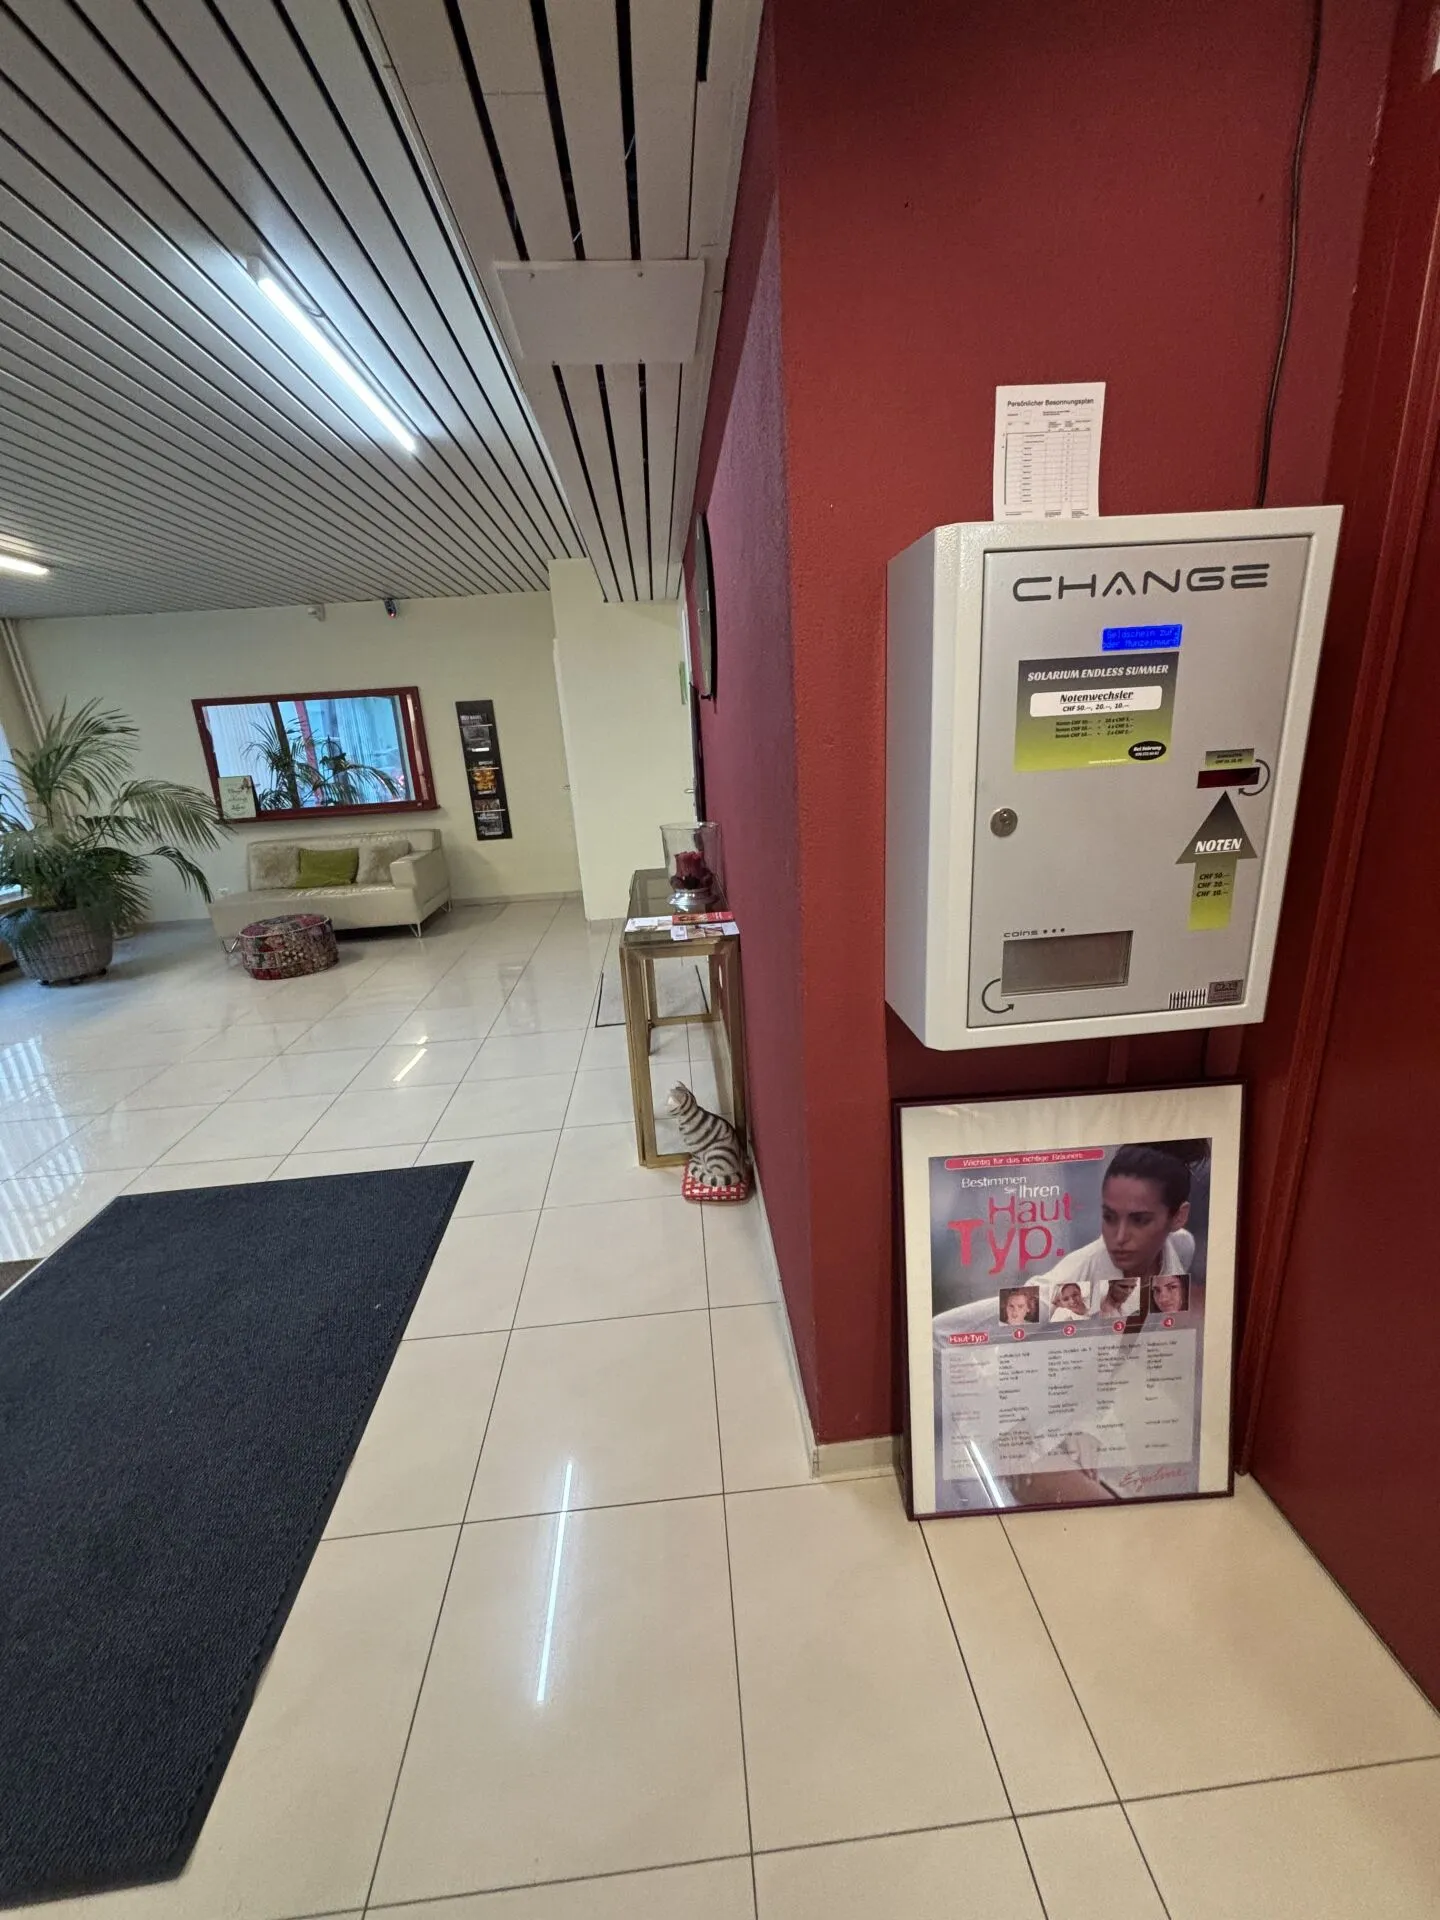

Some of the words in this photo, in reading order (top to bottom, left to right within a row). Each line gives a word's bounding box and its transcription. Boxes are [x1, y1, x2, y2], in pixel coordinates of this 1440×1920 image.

[1045, 398, 1094, 406] Besonnungsplan
[1013, 563, 1270, 602] CHANGE
[1027, 669, 1080, 682] SOLARIUM
[1080, 667, 1124, 678] ENDLESS
[1125, 665, 1169, 676] SUMMER
[1060, 690, 1134, 703] Notenwechsler
[1195, 838, 1242, 853] NOTEN
[1004, 929, 1038, 938] coins
[963, 1158, 990, 1167] Wichtig
[1006, 1156, 1020, 1164] das
[1022, 1155, 1049, 1164] richtige
[961, 1176, 1027, 1188] Bestimmen
[1019, 1184, 1060, 1198] Ihren
[947, 1218, 1065, 1276] Typ.
